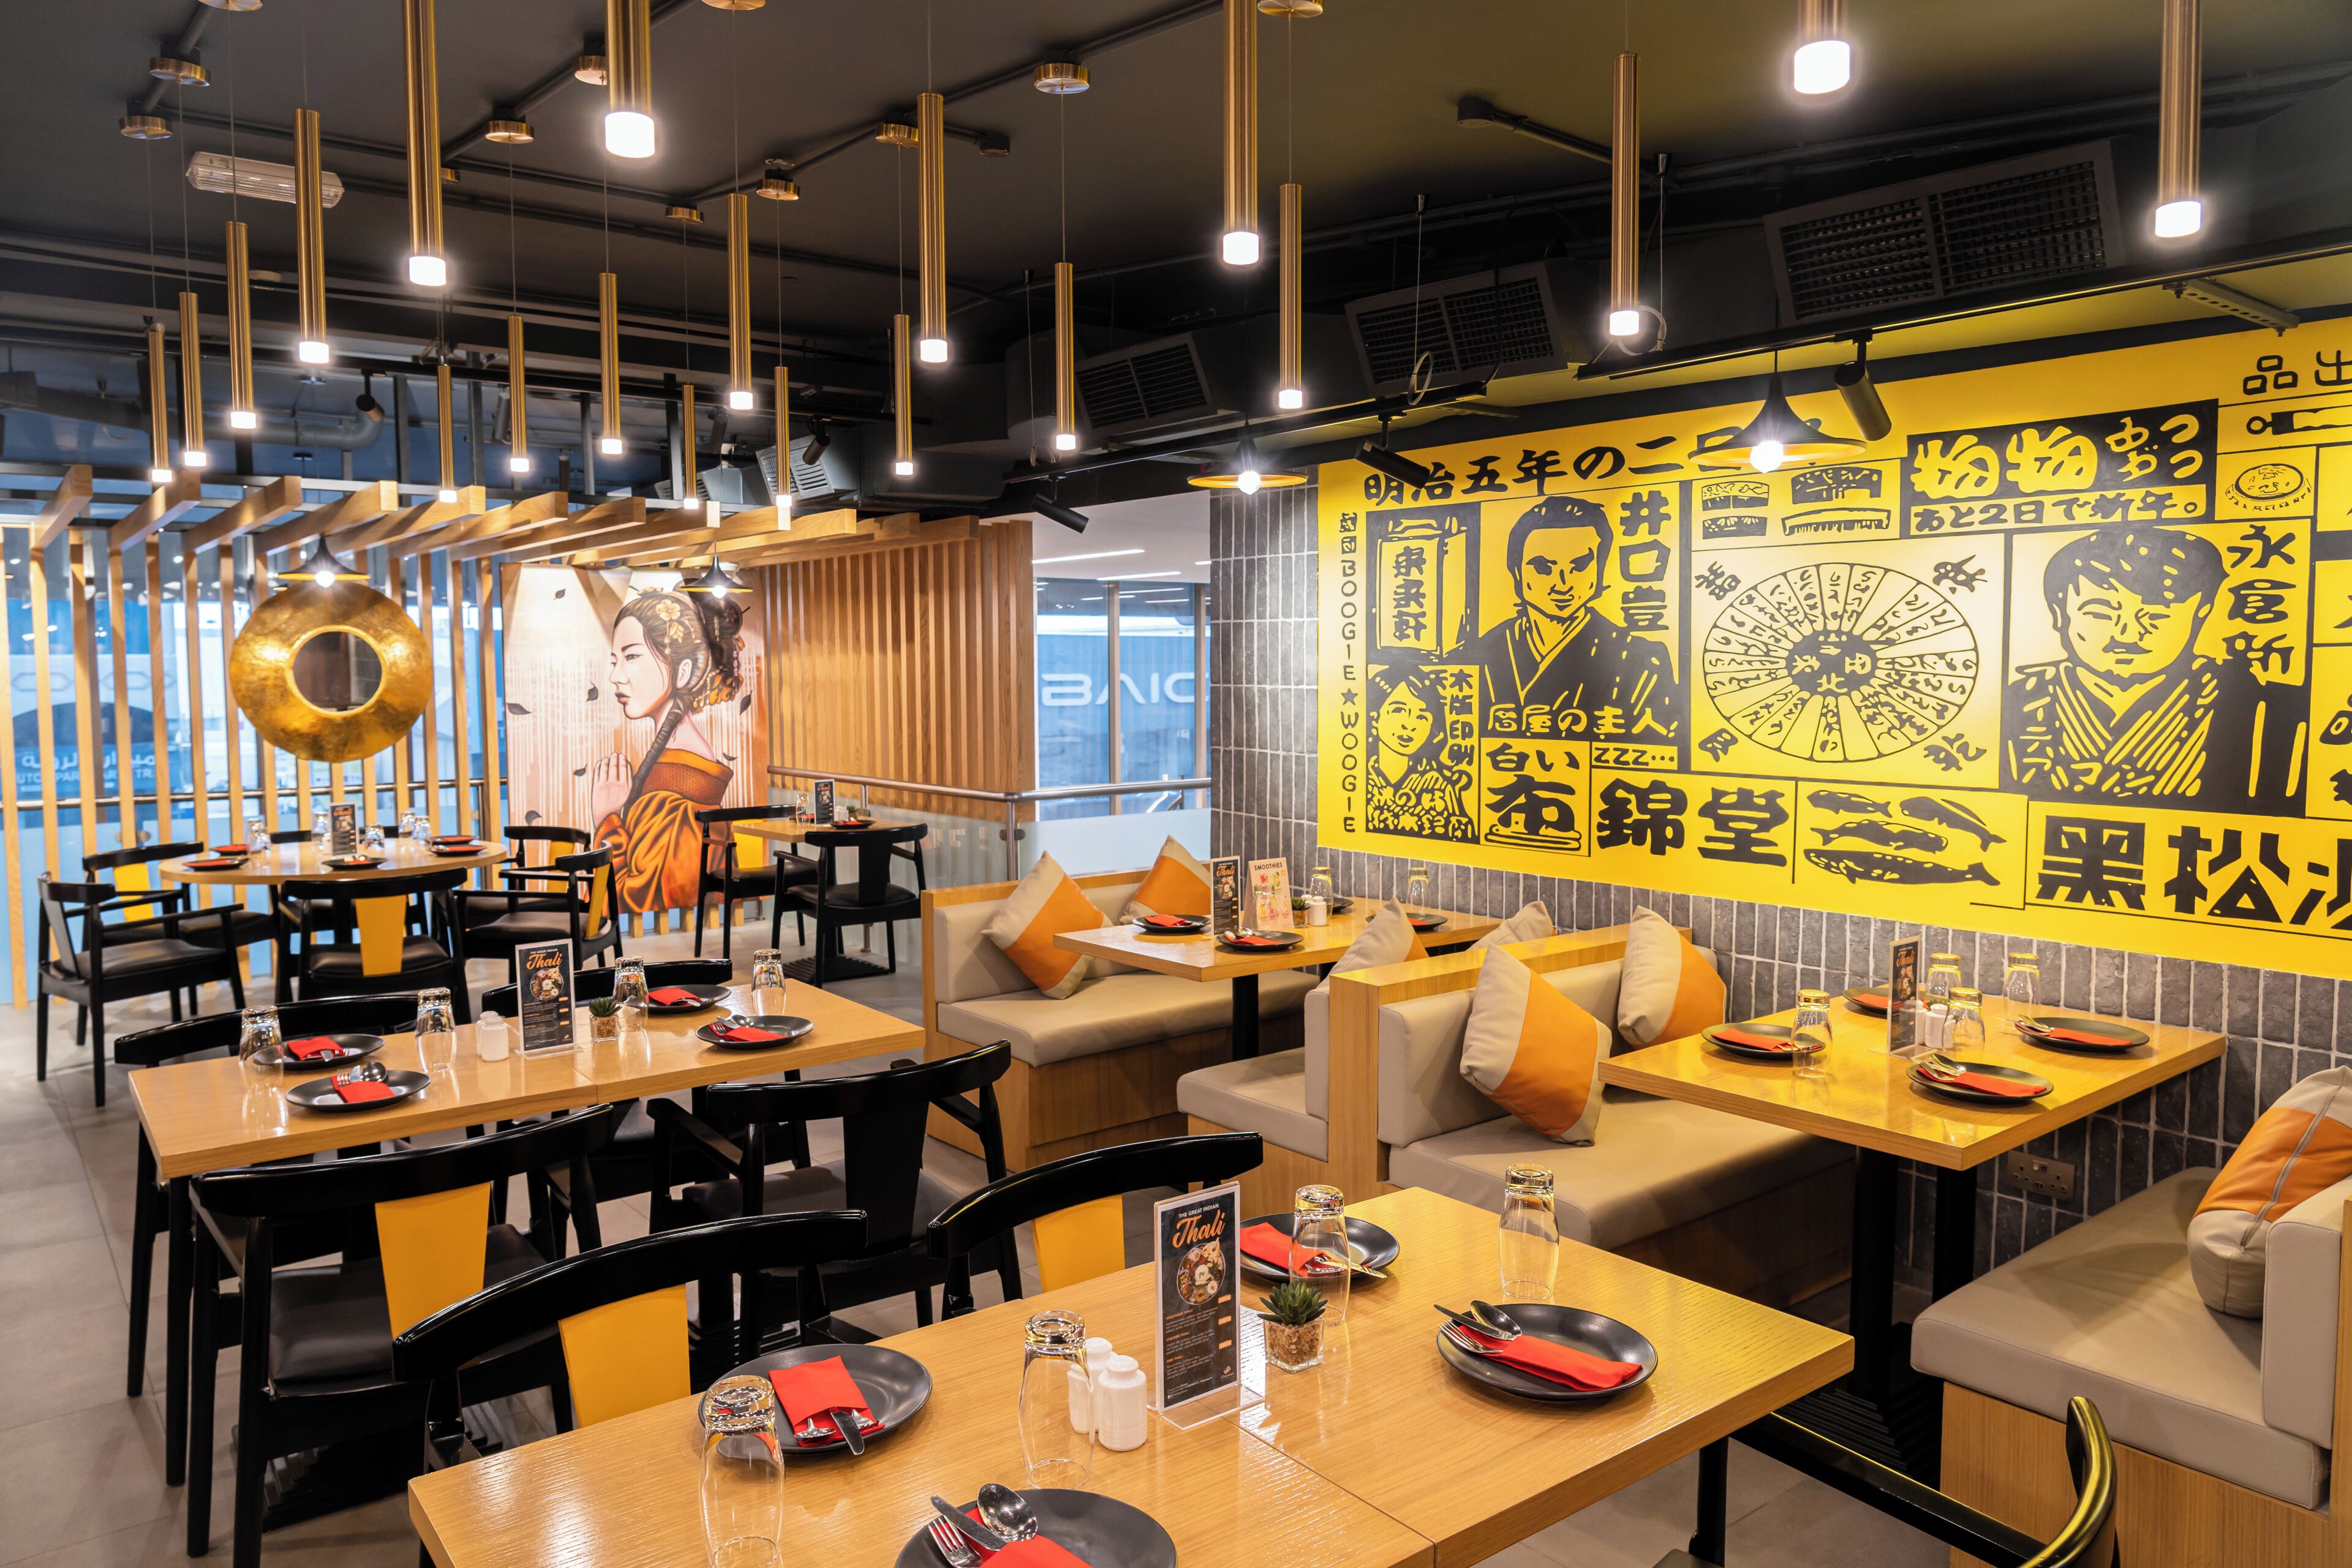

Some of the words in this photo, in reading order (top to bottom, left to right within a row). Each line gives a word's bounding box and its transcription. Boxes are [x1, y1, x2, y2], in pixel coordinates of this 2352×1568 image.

[1254, 862, 1283, 871] SMOOTHIES
[526, 951, 563, 970] Thali
[1188, 1207, 1202, 1216] GREAT
[1203, 1203, 1219, 1212] INDIAN
[1172, 1209, 1225, 1248] Thali
